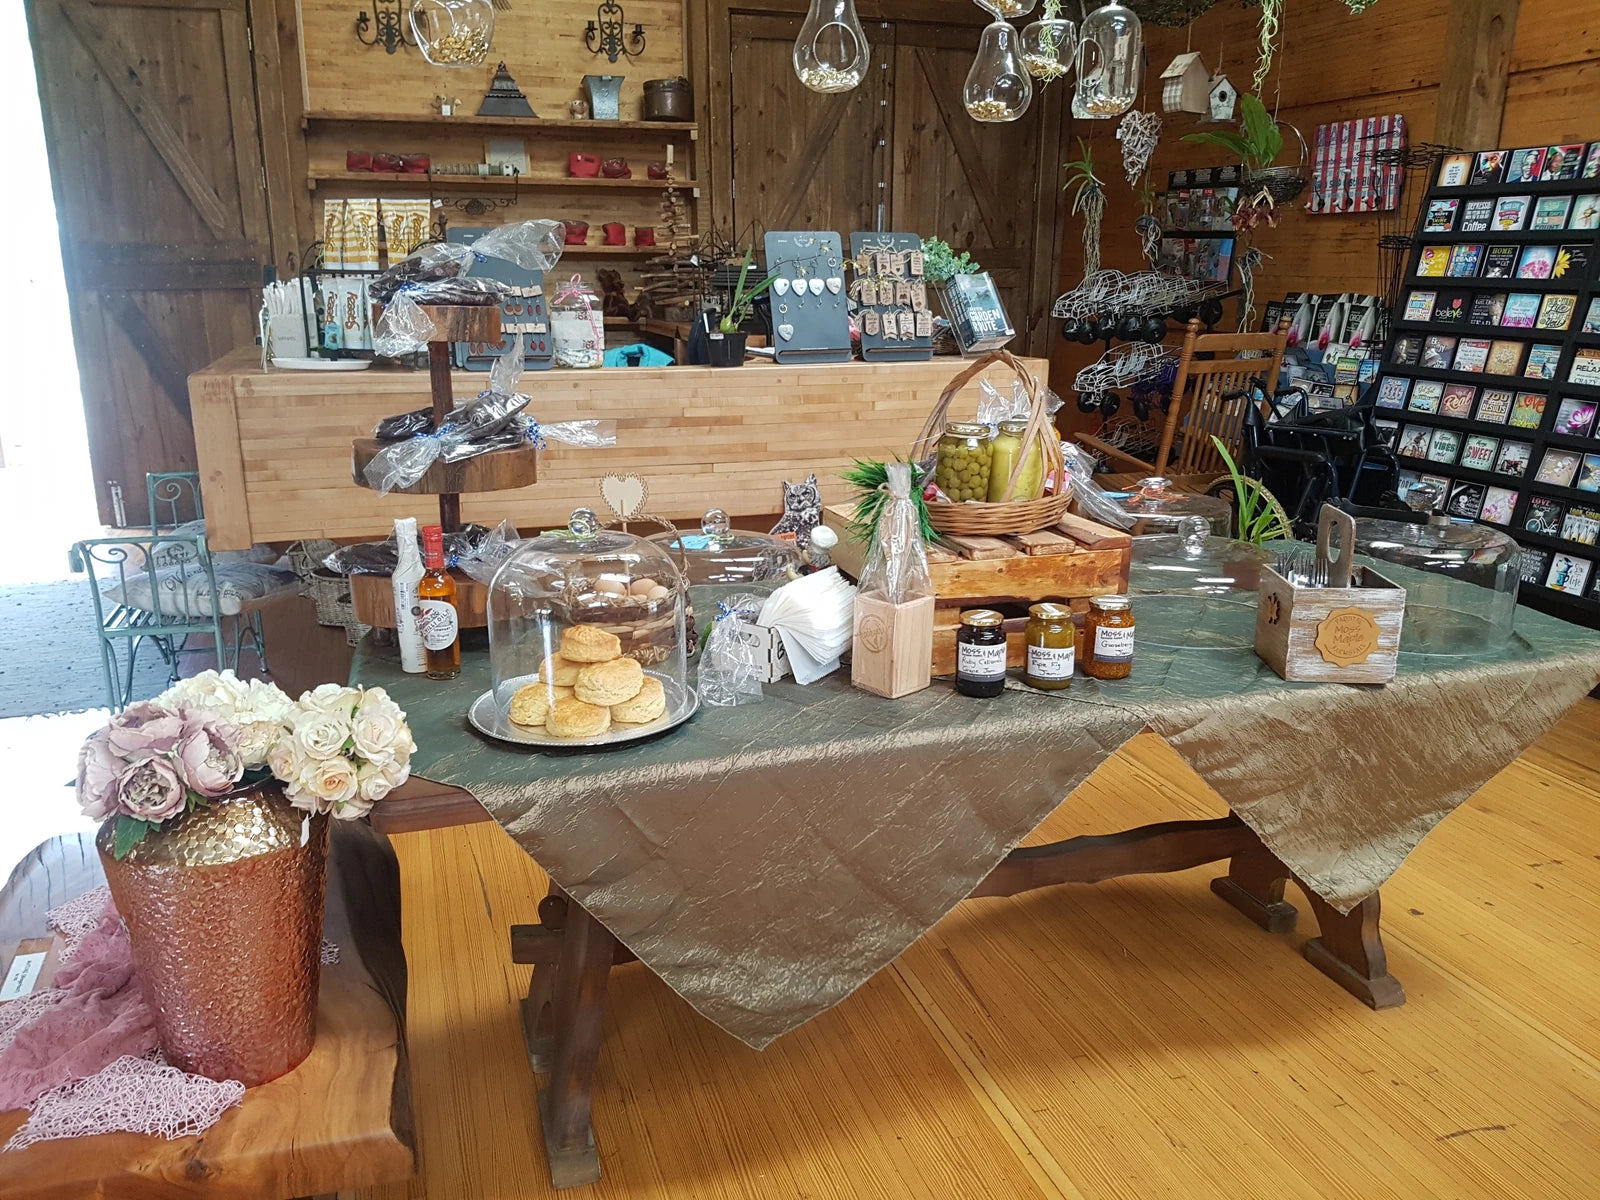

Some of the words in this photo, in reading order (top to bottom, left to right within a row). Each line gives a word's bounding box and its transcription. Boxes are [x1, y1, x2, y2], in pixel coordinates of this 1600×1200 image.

[1462, 221, 1486, 231] Coffee
[969, 308, 1001, 322] GARDEN
[973, 320, 998, 332] ROUTE
[1381, 384, 1404, 400] BIG
[1487, 392, 1509, 402] YOU
[1444, 391, 1471, 411] Real
[1433, 441, 1456, 453] VIBES
[1467, 446, 1493, 461] SWEET
[1334, 624, 1361, 634] Moss
[1333, 633, 1364, 646] Maple
